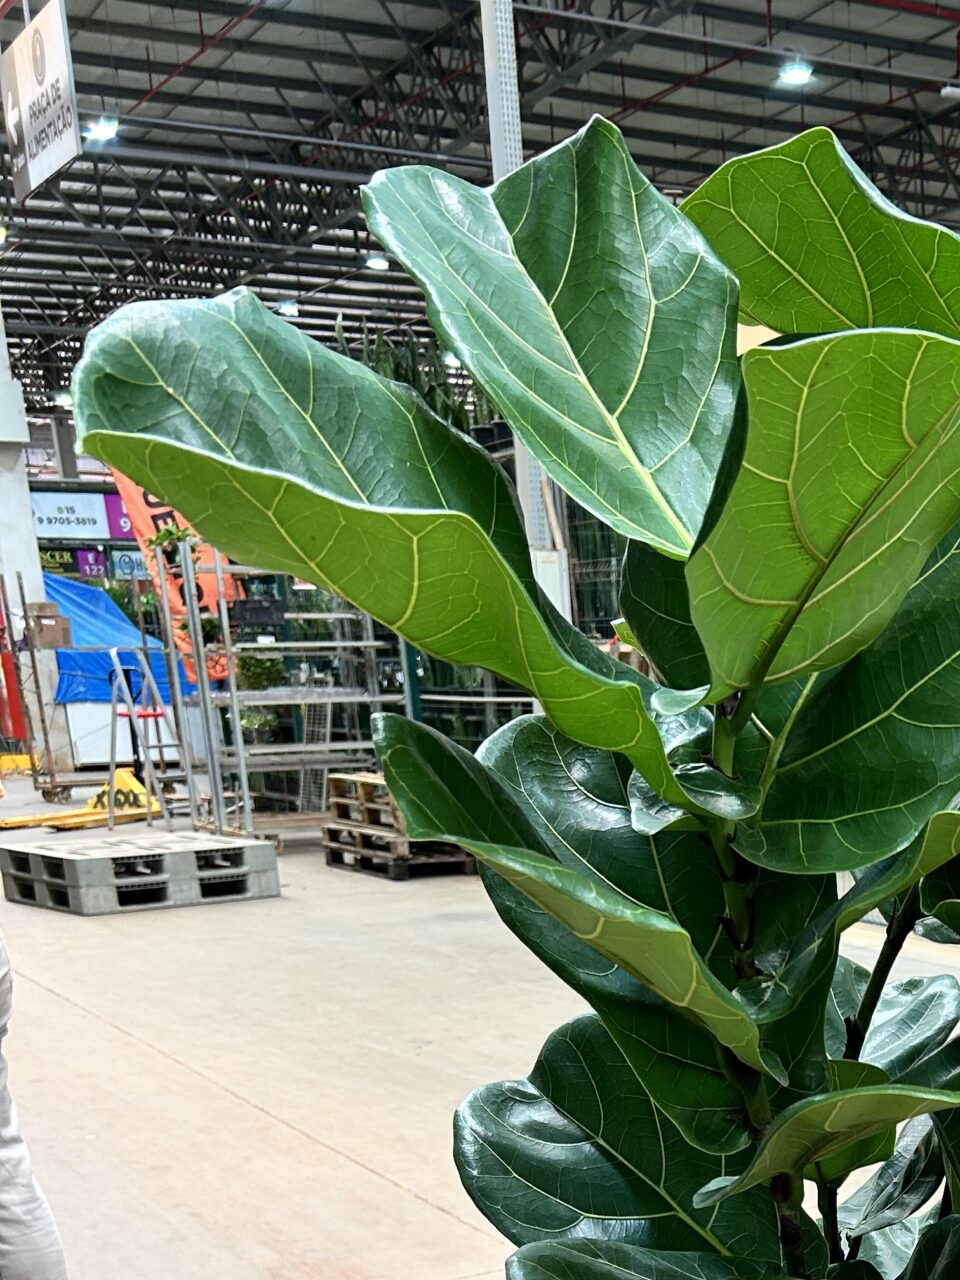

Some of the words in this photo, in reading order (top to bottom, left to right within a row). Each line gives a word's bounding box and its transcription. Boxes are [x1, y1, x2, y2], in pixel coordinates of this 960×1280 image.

[28, 88, 51, 127] PRAÇA
[50, 78, 62, 106] DE
[27, 105, 73, 162] ALIMENTAÇÃO
